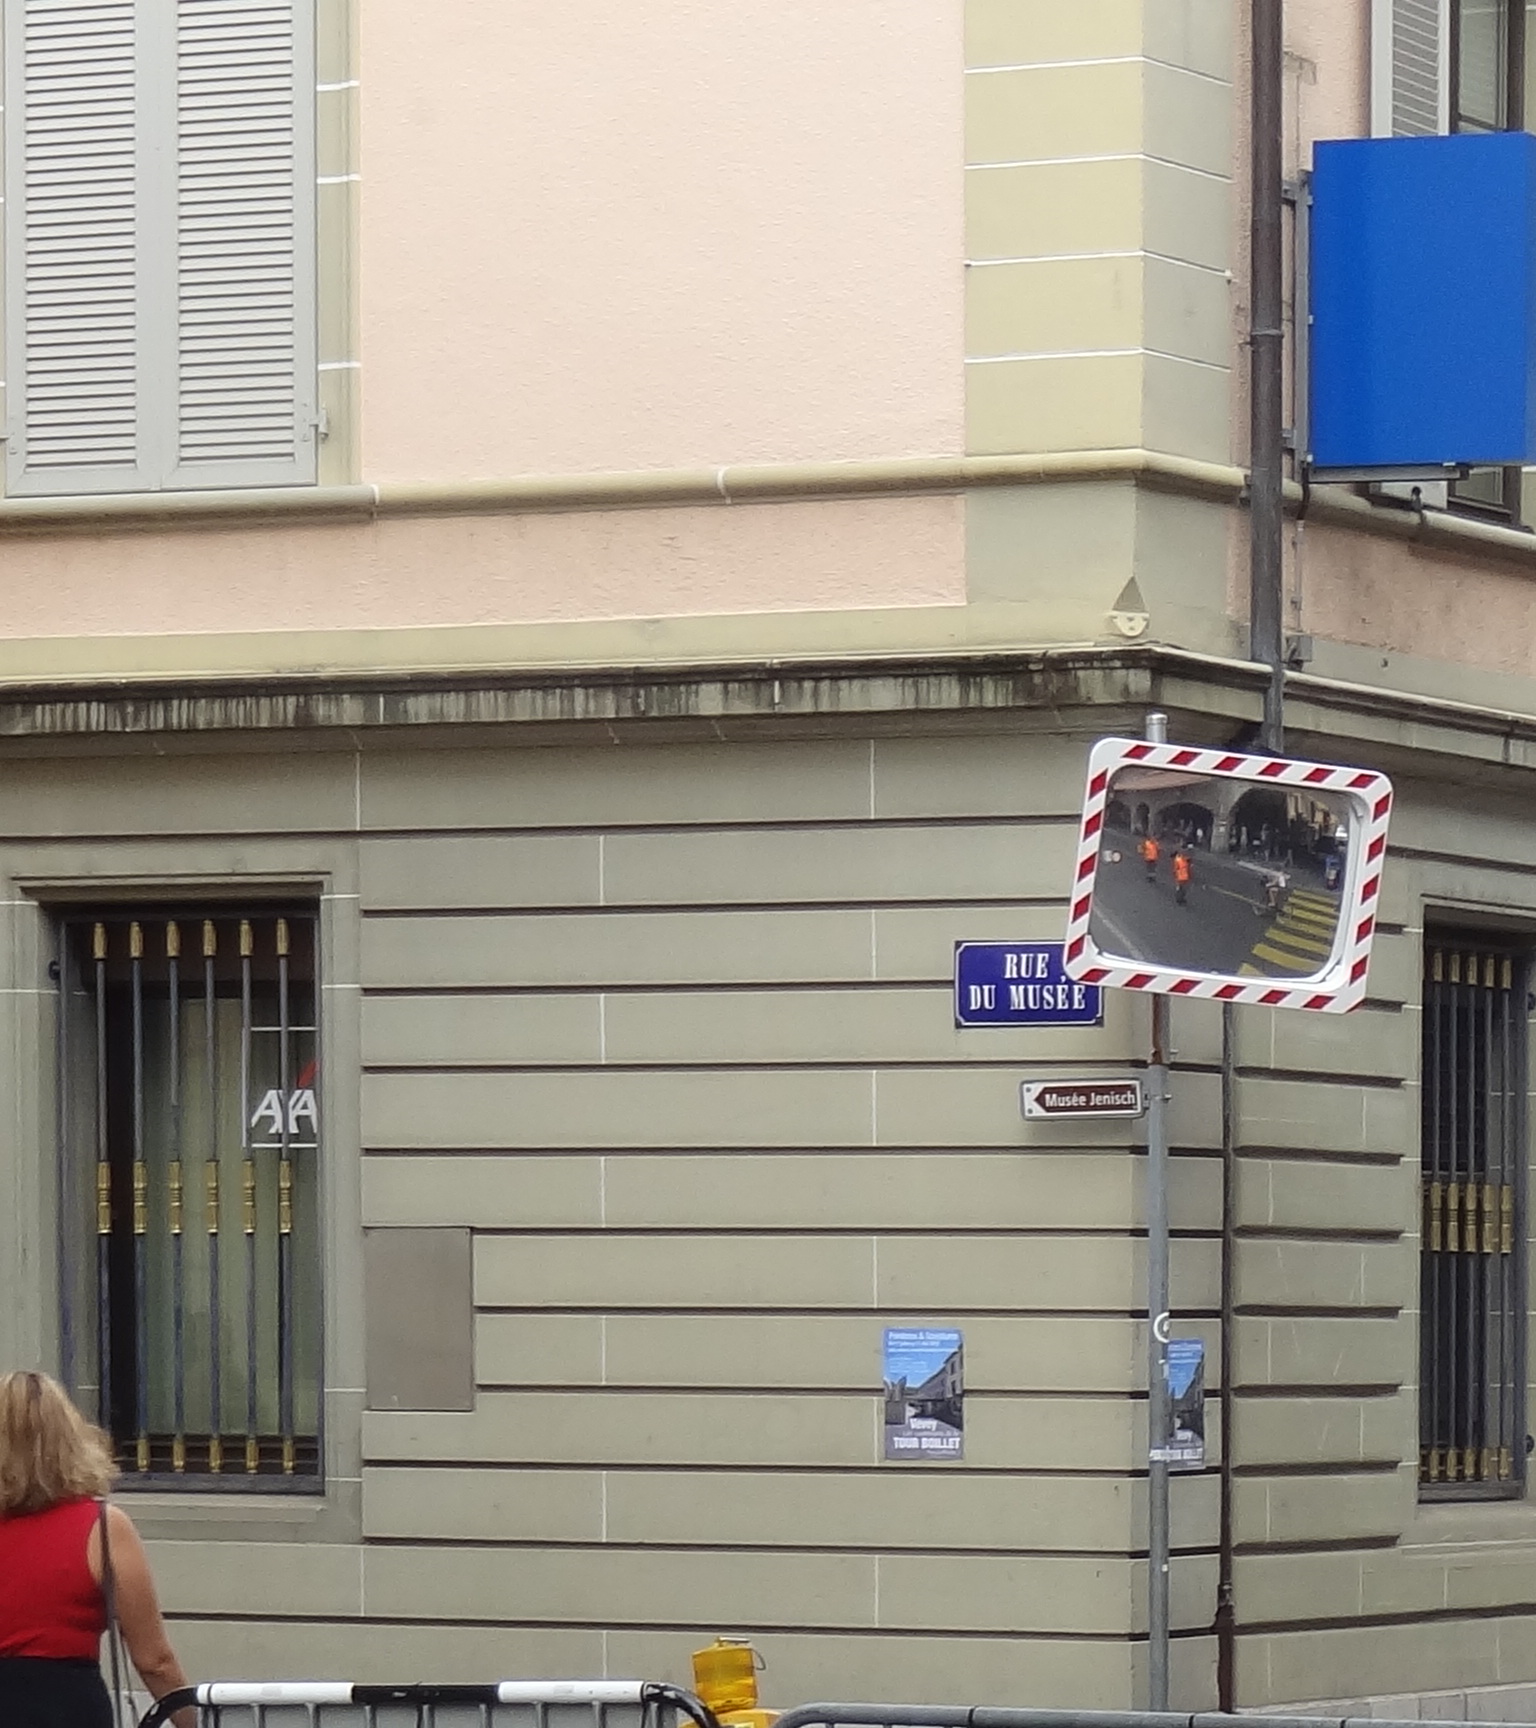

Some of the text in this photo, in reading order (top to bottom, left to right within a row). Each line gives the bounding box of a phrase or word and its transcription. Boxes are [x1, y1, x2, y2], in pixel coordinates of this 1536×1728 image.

[1004, 953, 1049, 978] RUE
[969, 974, 1086, 1010] DU MUSÉE
[1045, 1090, 1136, 1107] Musée Jenisch
